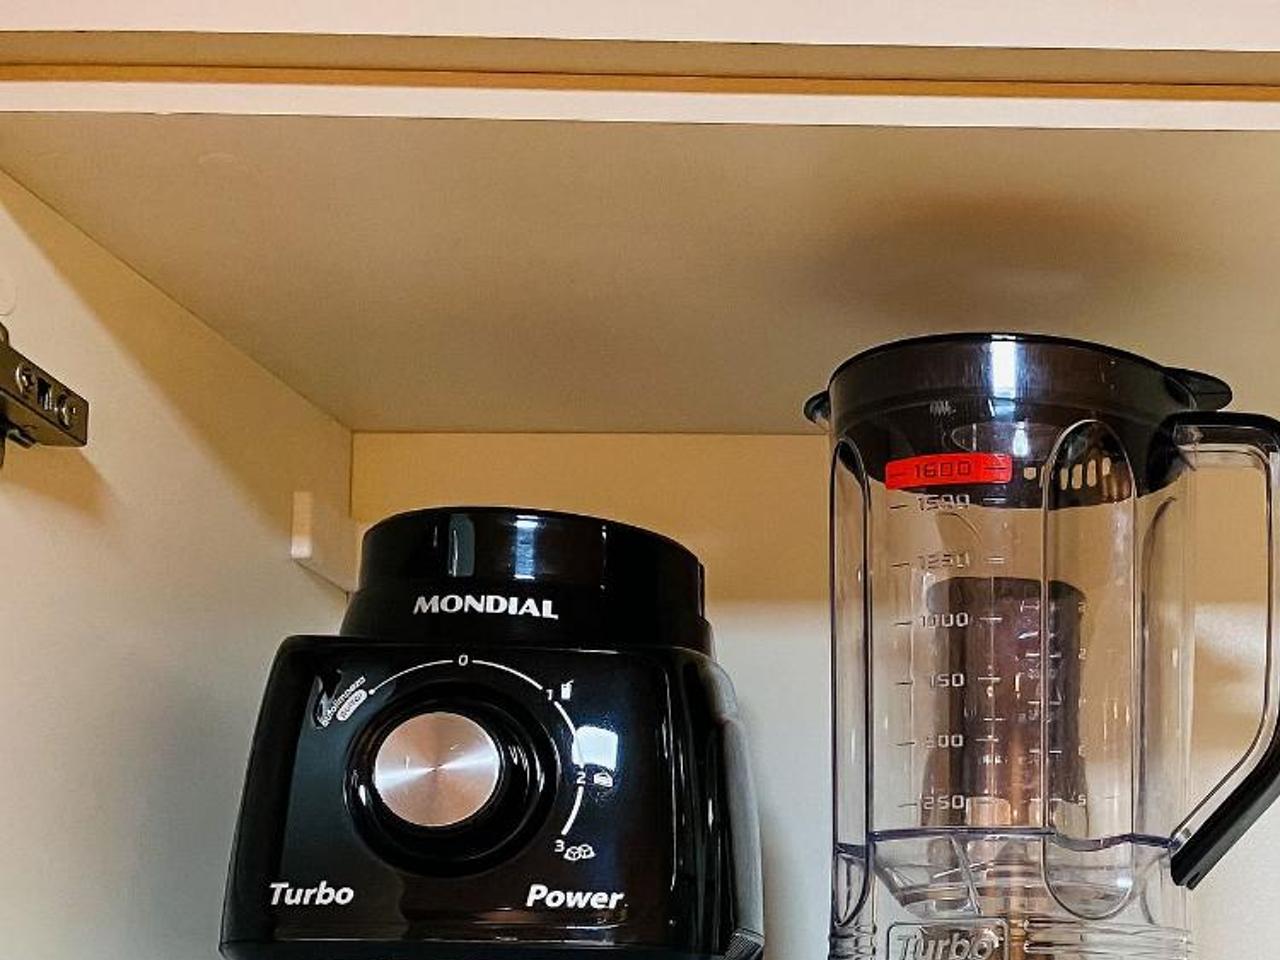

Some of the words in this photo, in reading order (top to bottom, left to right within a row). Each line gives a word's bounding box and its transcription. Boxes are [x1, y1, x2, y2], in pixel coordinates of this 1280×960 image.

[914, 460, 972, 478] 1600
[413, 594, 559, 620] MONDIAL
[458, 654, 469, 667] 0
[545, 689, 554, 701] 1
[576, 771, 587, 785] 2
[923, 794, 965, 810] 250
[554, 839, 566, 853] 3
[269, 880, 355, 906] Turbo
[525, 883, 625, 909] Power
